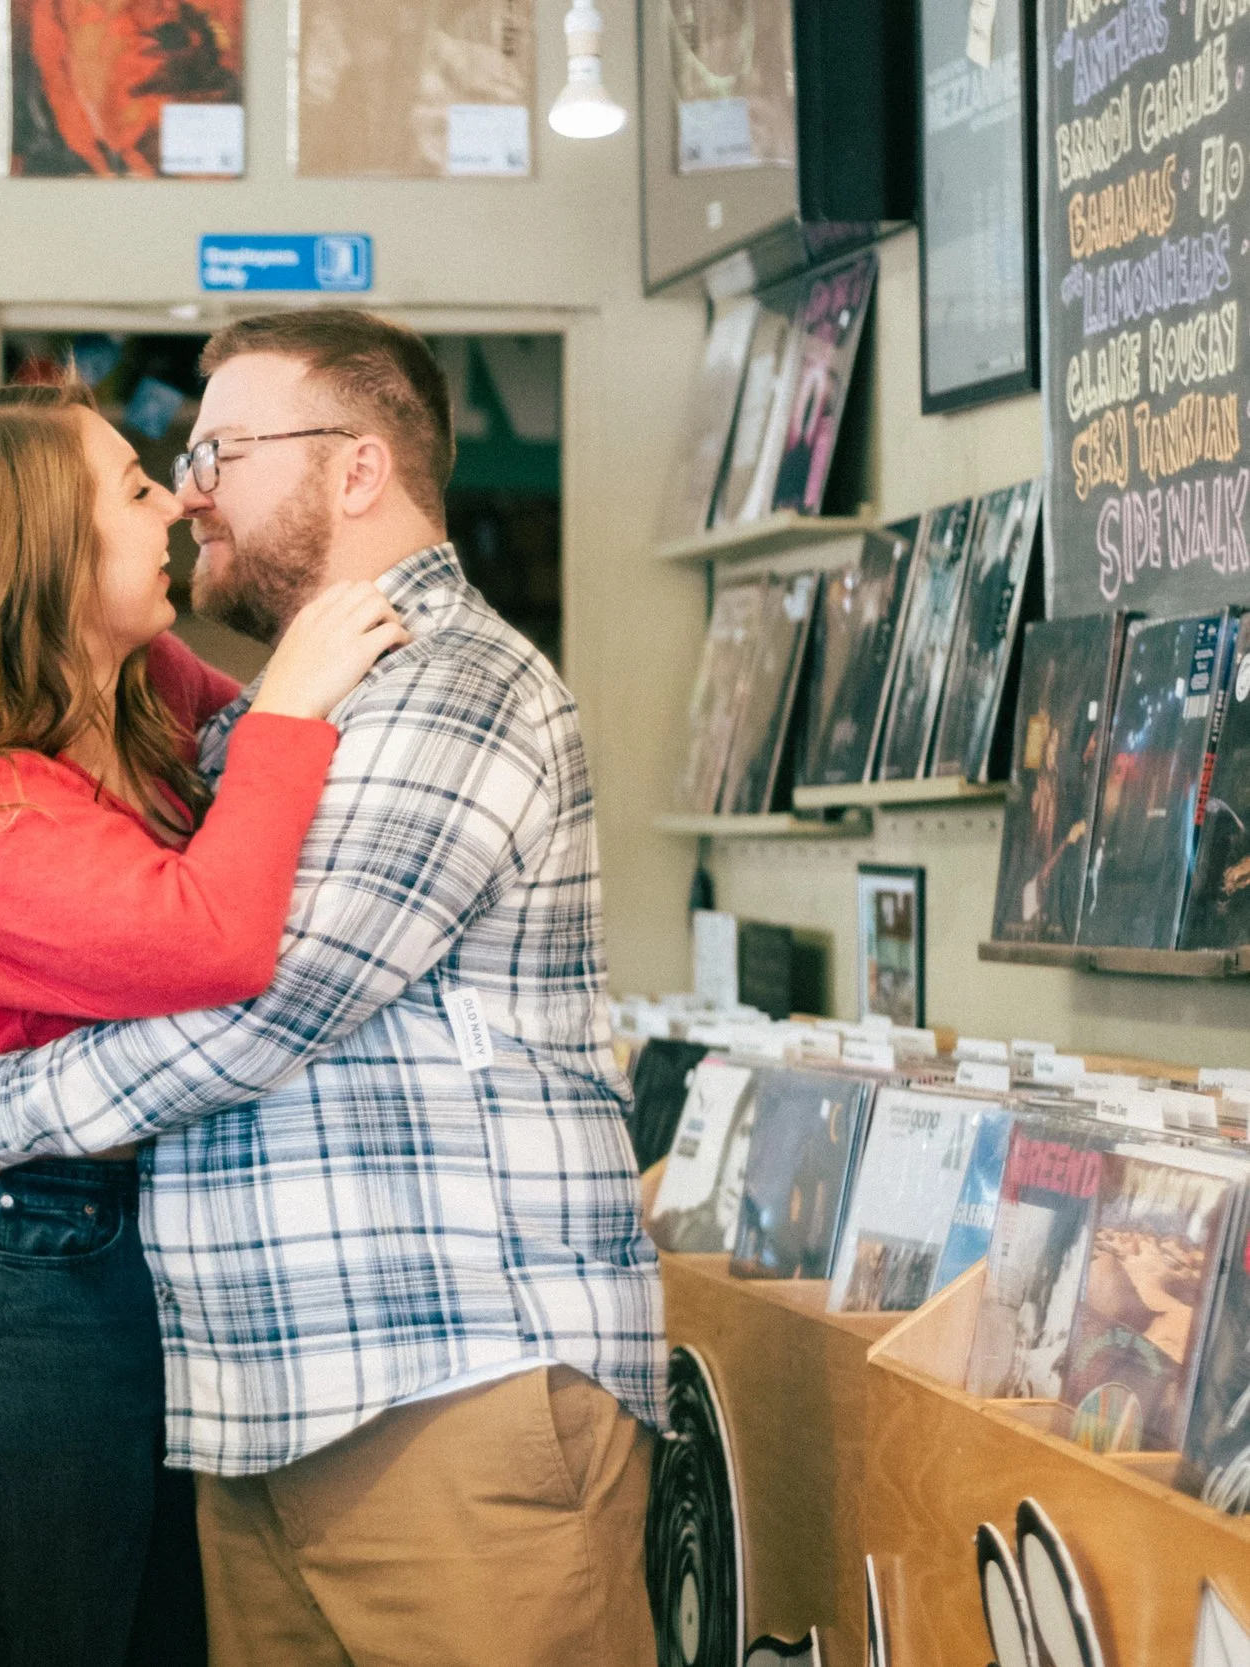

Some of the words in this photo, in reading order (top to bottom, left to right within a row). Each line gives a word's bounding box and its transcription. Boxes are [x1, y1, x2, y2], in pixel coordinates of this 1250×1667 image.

[1055, 82, 1132, 191] BRANDI
[1138, 33, 1229, 154] CARLILE
[1068, 152, 1178, 262] BAHAMAS
[1082, 223, 1232, 337] LEMONHEADS
[1066, 330, 1142, 423] CLAIRE
[1150, 300, 1238, 395] ROUSAY
[1071, 405, 1130, 502] SERJ
[1134, 391, 1240, 485] TANKIAN
[463, 998, 478, 1021] OLD
[470, 1022, 487, 1055] NAVY
